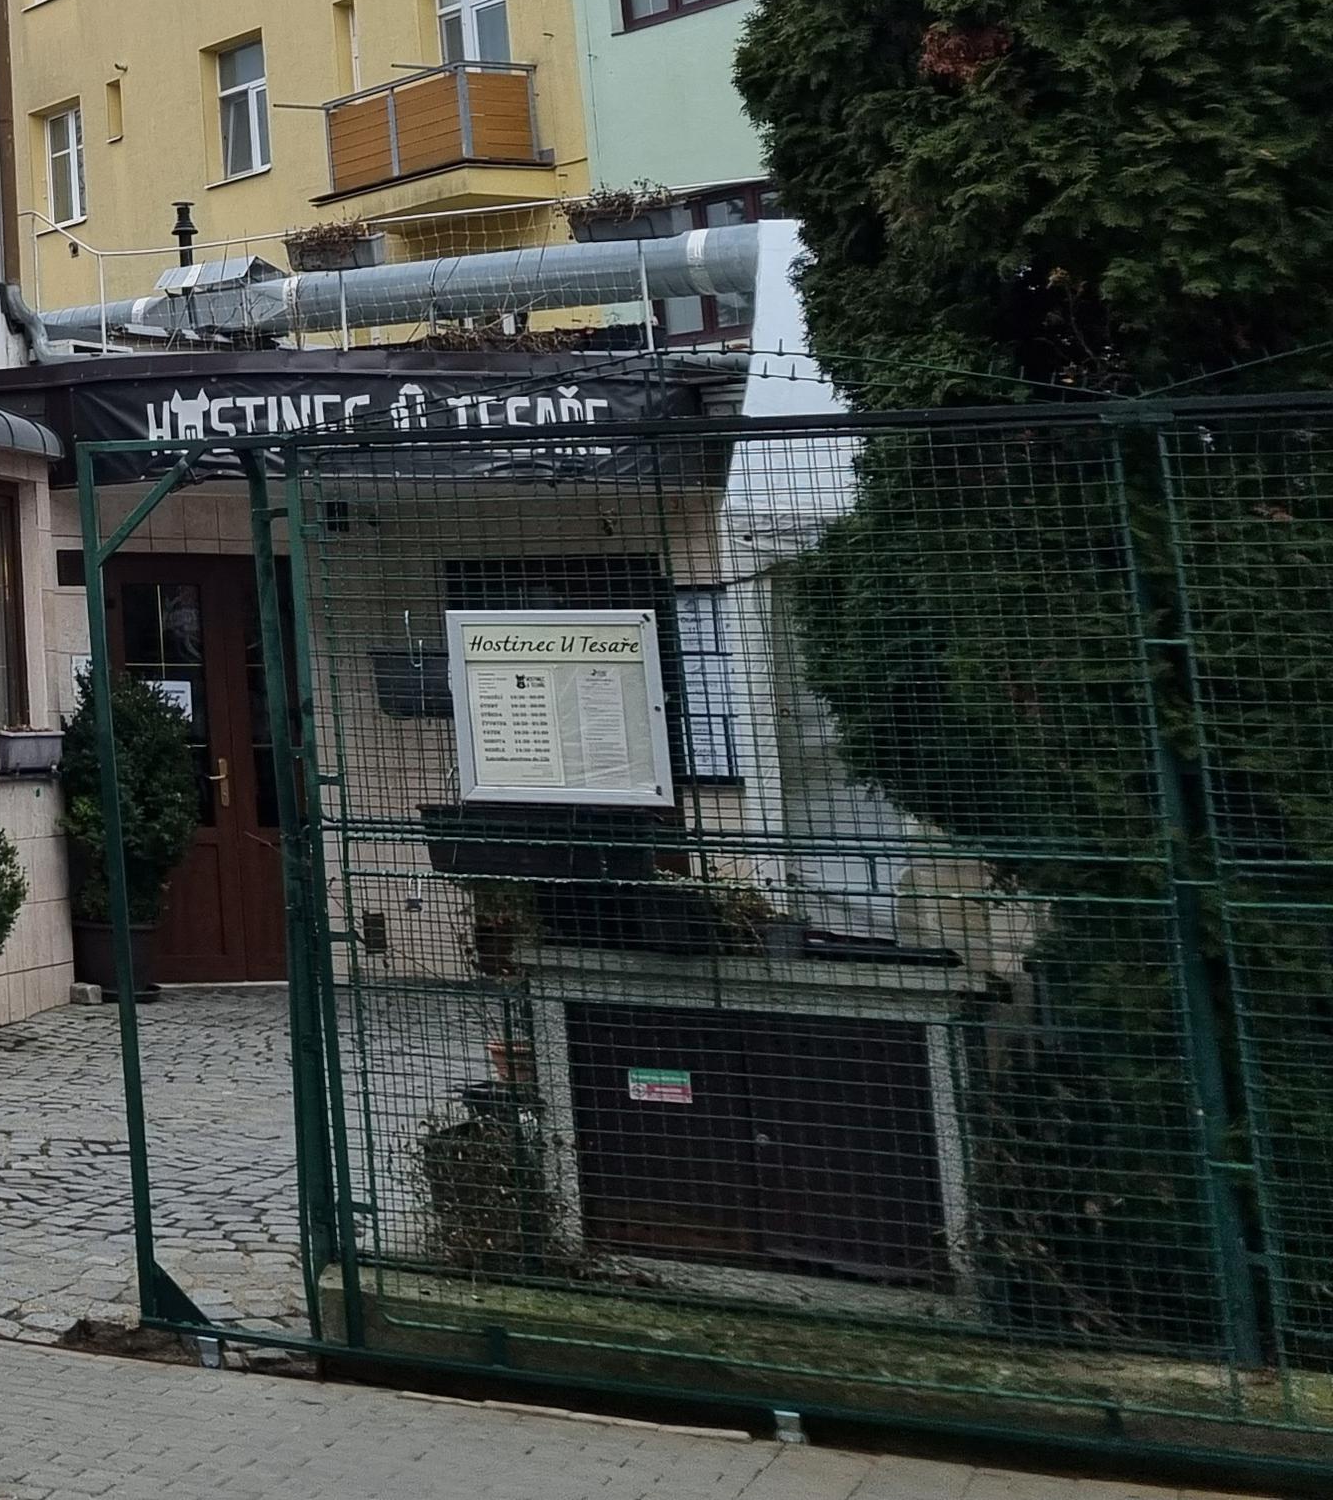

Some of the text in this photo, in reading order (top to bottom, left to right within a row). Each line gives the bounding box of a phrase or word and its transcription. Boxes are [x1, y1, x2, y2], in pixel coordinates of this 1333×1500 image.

[468, 634, 640, 654] Hostinec U Tesaře
